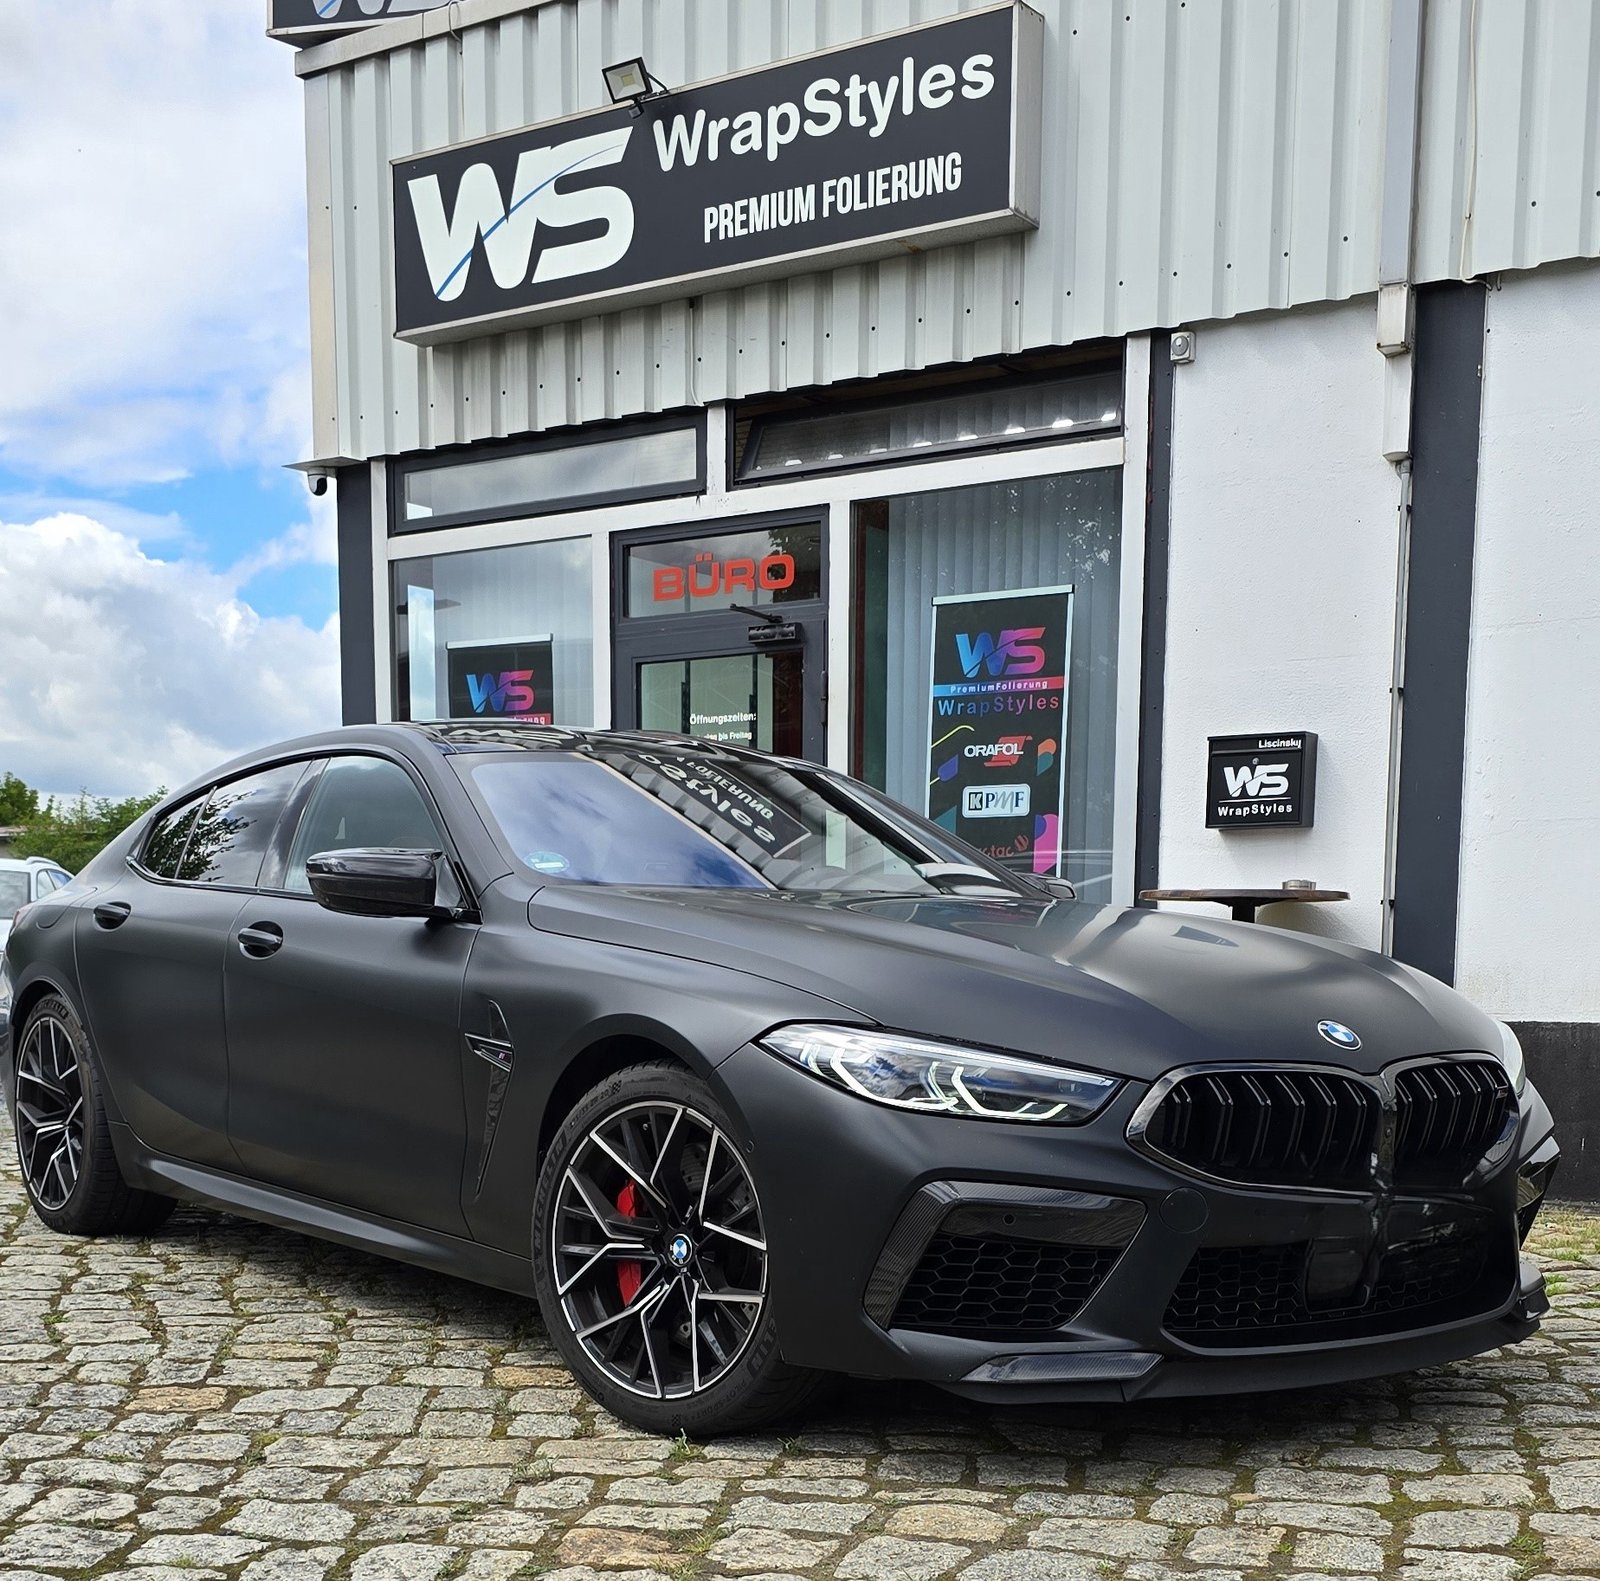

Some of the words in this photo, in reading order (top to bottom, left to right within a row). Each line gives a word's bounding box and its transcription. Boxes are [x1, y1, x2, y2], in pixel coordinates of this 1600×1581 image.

[653, 54, 994, 172] WrapStyles
[407, 126, 634, 302] WS
[704, 184, 816, 243] PREMIUM
[822, 151, 962, 218] FOLIERUNG
[653, 552, 795, 602] BÜRO
[956, 627, 1046, 678] WS
[466, 669, 534, 713] WS
[938, 694, 1059, 717] WrapStyles
[950, 681, 1048, 694] PremiumFolierung
[964, 743, 1024, 758] ORAFOL
[1223, 763, 1289, 797] WS
[968, 791, 1025, 814] KPMF
[1218, 803, 1293, 817] WrapStyles
